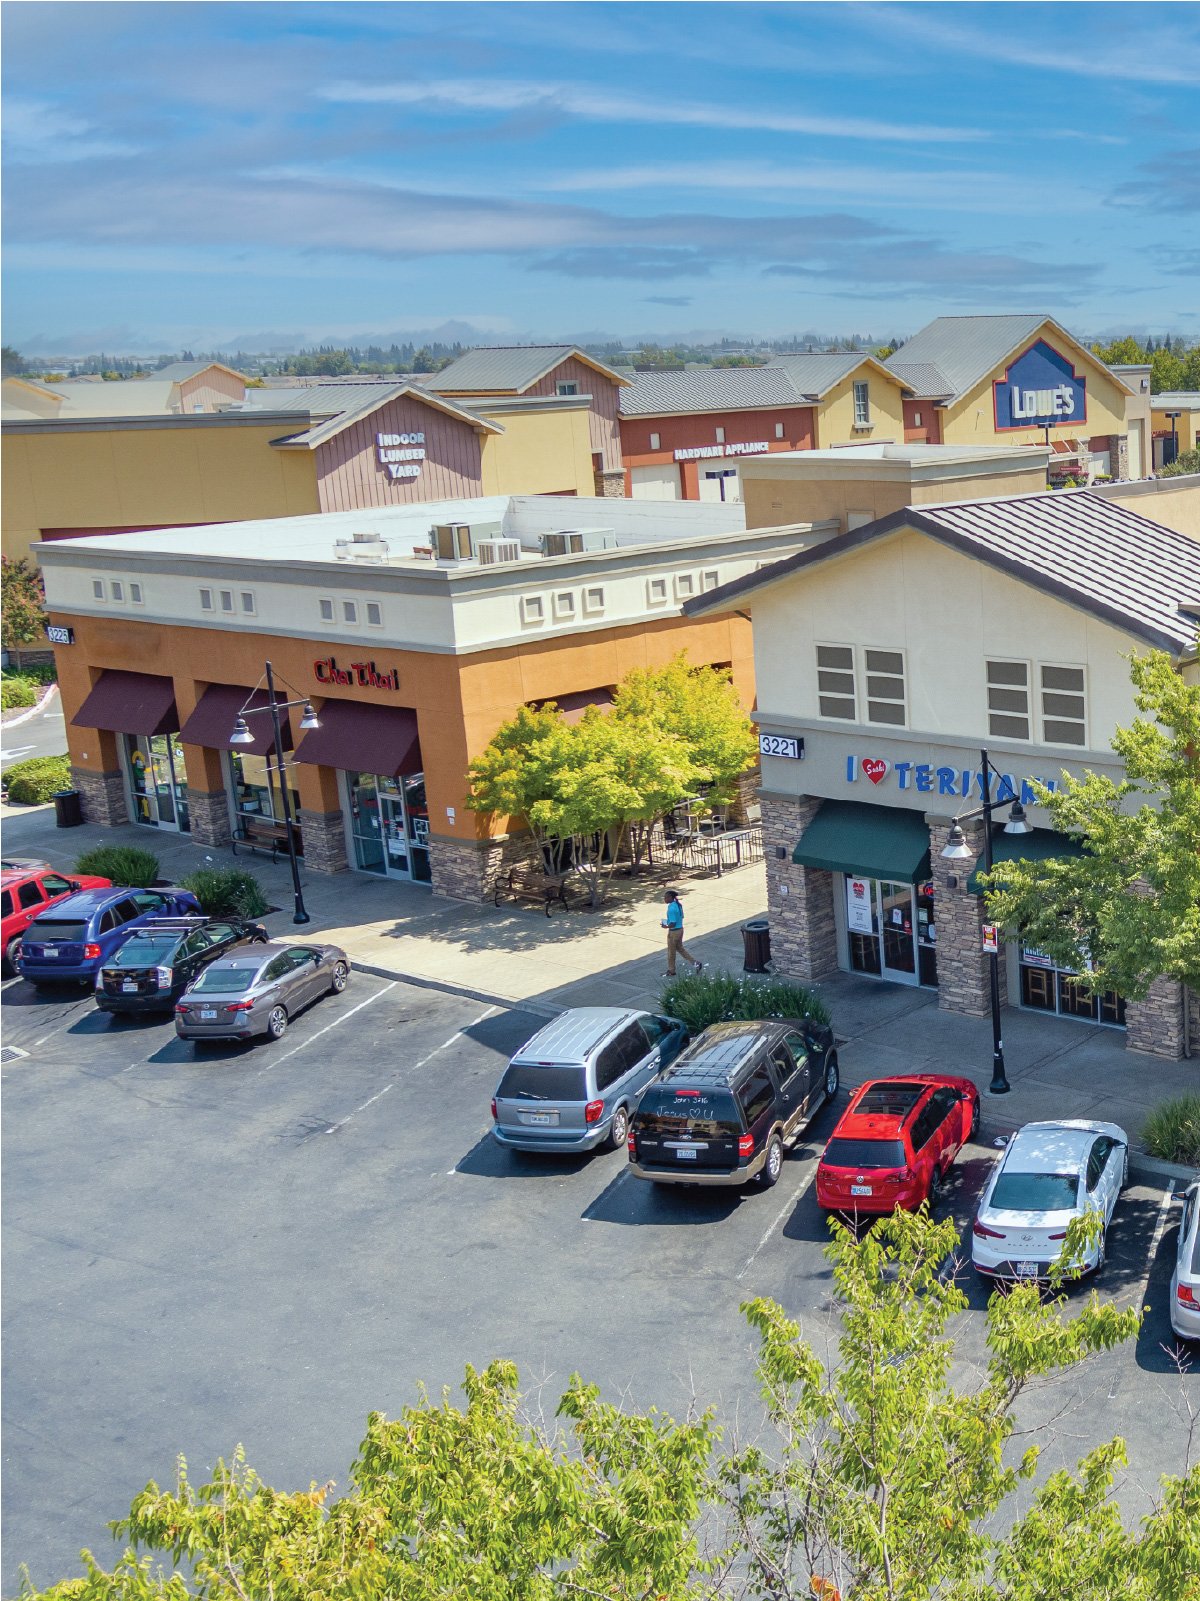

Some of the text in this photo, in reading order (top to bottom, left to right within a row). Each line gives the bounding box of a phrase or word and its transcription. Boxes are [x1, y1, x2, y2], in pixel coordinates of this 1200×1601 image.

[1011, 384, 1075, 418] LOWE'S
[377, 432, 425, 447] INDOOR
[379, 448, 426, 463] LUMBER
[674, 441, 769, 460] HARDWARE APPLIANCE
[387, 464, 421, 479] YARD
[48, 627, 68, 643] 3225
[313, 657, 399, 691] Cha Thai
[762, 736, 797, 757] 3221
[847, 755, 858, 783] I
[656, 1105, 688, 1119] Jesus
